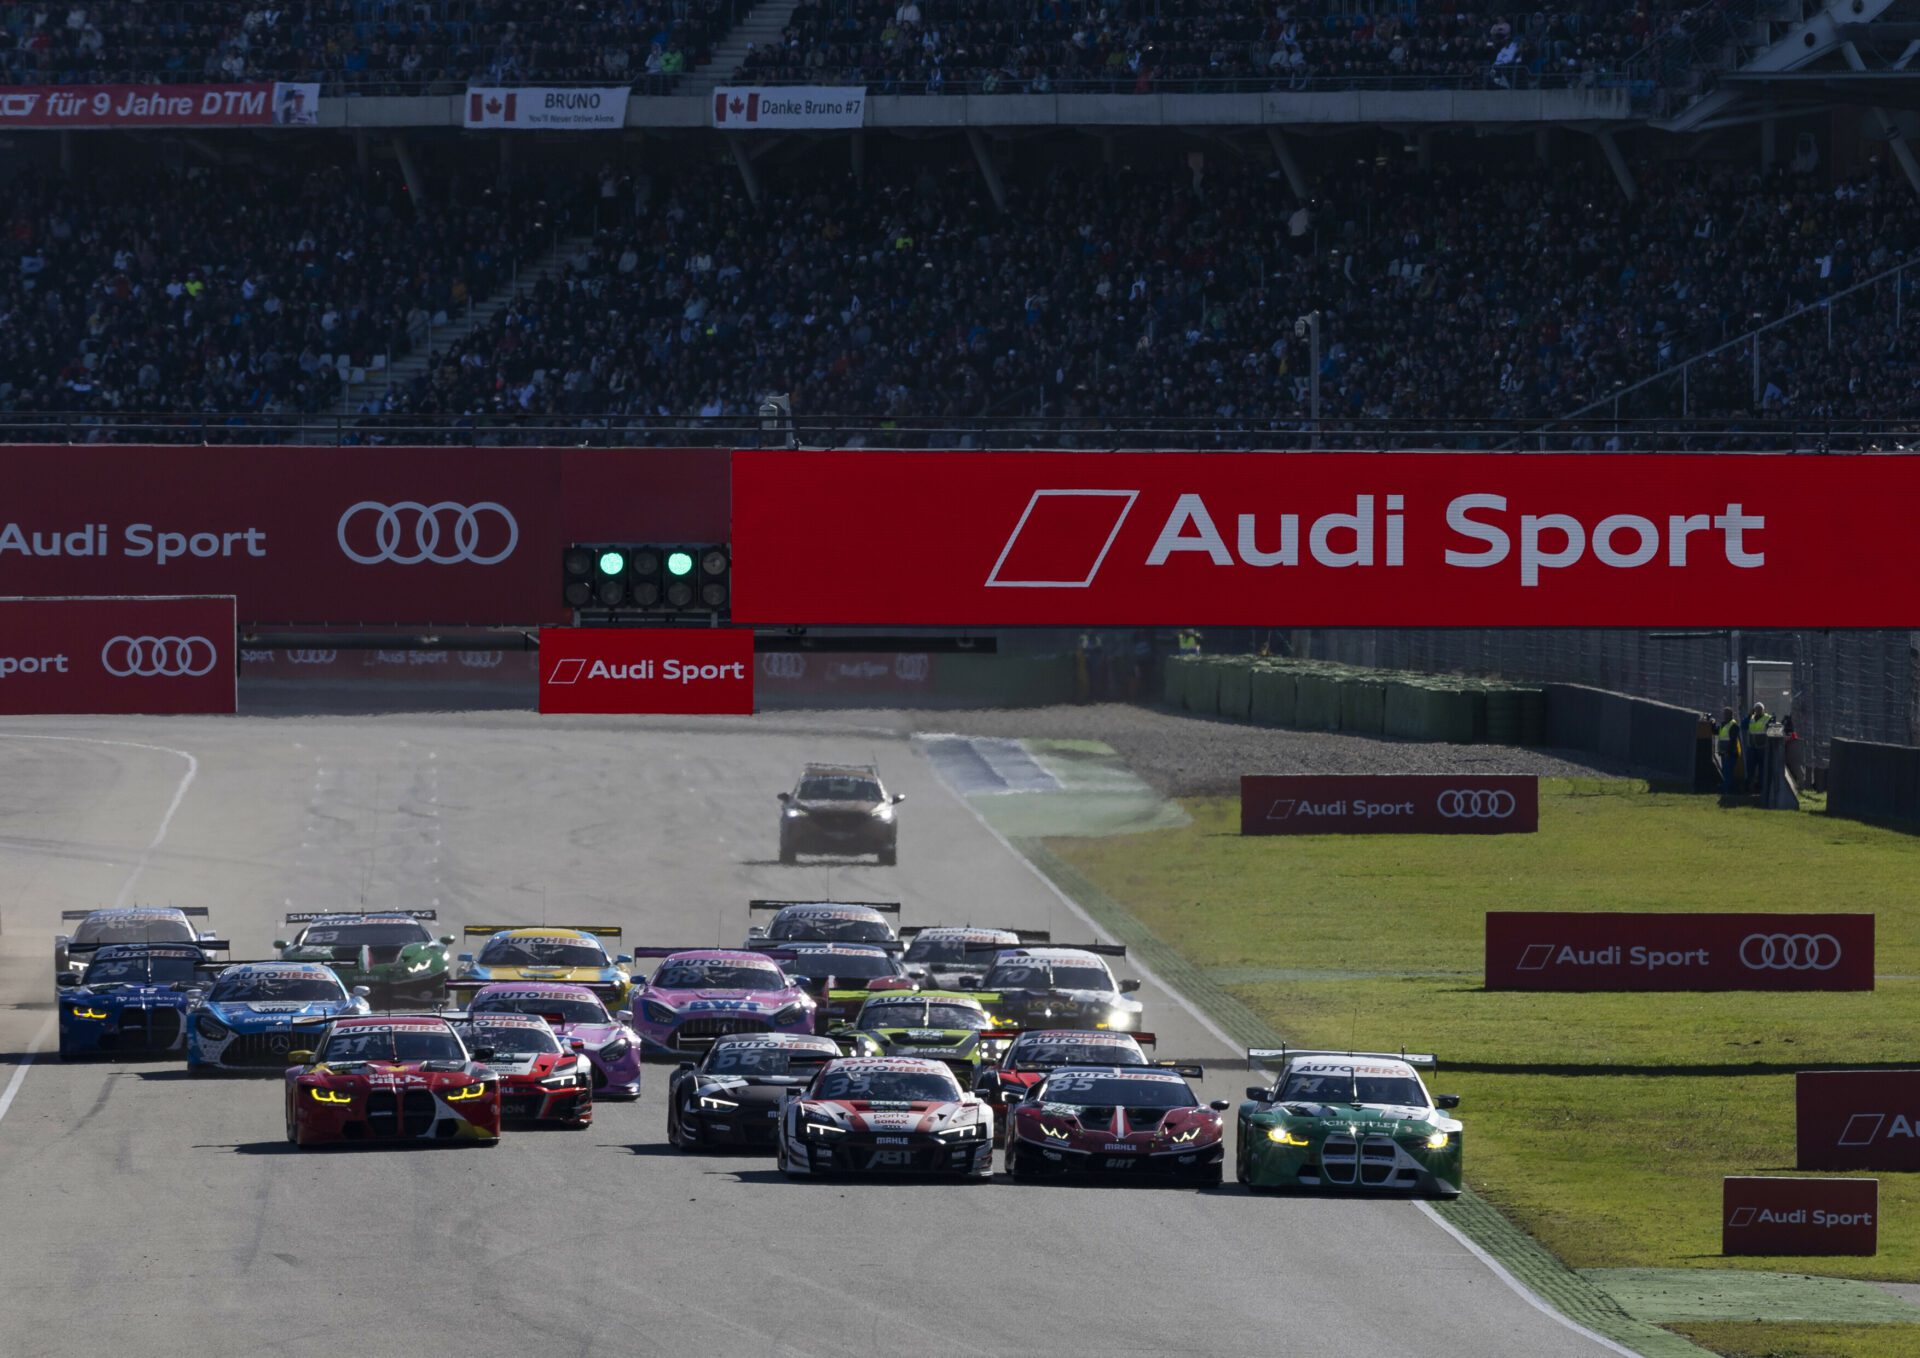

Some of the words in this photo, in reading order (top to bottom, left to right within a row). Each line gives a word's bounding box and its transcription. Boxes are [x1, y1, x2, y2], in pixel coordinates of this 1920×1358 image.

[46, 92, 87, 116] für
[92, 92, 111, 116] 9
[116, 92, 193, 116] Jahre
[200, 91, 266, 115] DTM
[545, 93, 601, 109] BRUNO
[762, 100, 802, 115] Danke
[805, 100, 842, 115] Bruno
[845, 100, 861, 115] #7
[0, 523, 108, 557] Audi
[124, 523, 267, 565] Sport
[1145, 493, 1404, 567] Audi
[1443, 493, 1765, 587] Sport
[0, 652, 69, 678] port
[588, 659, 654, 680] Audi
[662, 659, 745, 684] Sport
[1296, 800, 1347, 815] Audi
[1353, 800, 1414, 818] Sport
[306, 931, 340, 943] 63
[500, 937, 591, 946] AUTOHERO
[102, 950, 198, 959] AUTOHERO
[1556, 945, 1622, 965] Audi
[1630, 945, 1709, 970] Sport
[673, 959, 769, 969] AUTOHERO
[1003, 957, 1097, 967] AUTOHERO
[229, 971, 328, 981] AUTOHERO
[487, 991, 590, 1000] AUTOHERO
[689, 1000, 764, 1011] BWT
[339, 1023, 448, 1034] AUTOHERO
[450, 1020, 543, 1029] UTOHERO
[329, 1036, 370, 1055] 31
[716, 1050, 764, 1069] 66
[831, 1065, 944, 1073] AUTOHERO
[1297, 1065, 1410, 1076] AUTOHERO
[369, 1075, 427, 1084] HELIX
[1063, 1072, 1173, 1082] AUTOHERO
[828, 1077, 872, 1096] 33
[1049, 1078, 1095, 1092] 85
[876, 1136, 909, 1145] MAHLE
[1104, 1143, 1137, 1151] MAHLE
[865, 1150, 913, 1169] ABT
[1757, 1208, 1807, 1224] Audi
[1812, 1209, 1873, 1228] Sport
